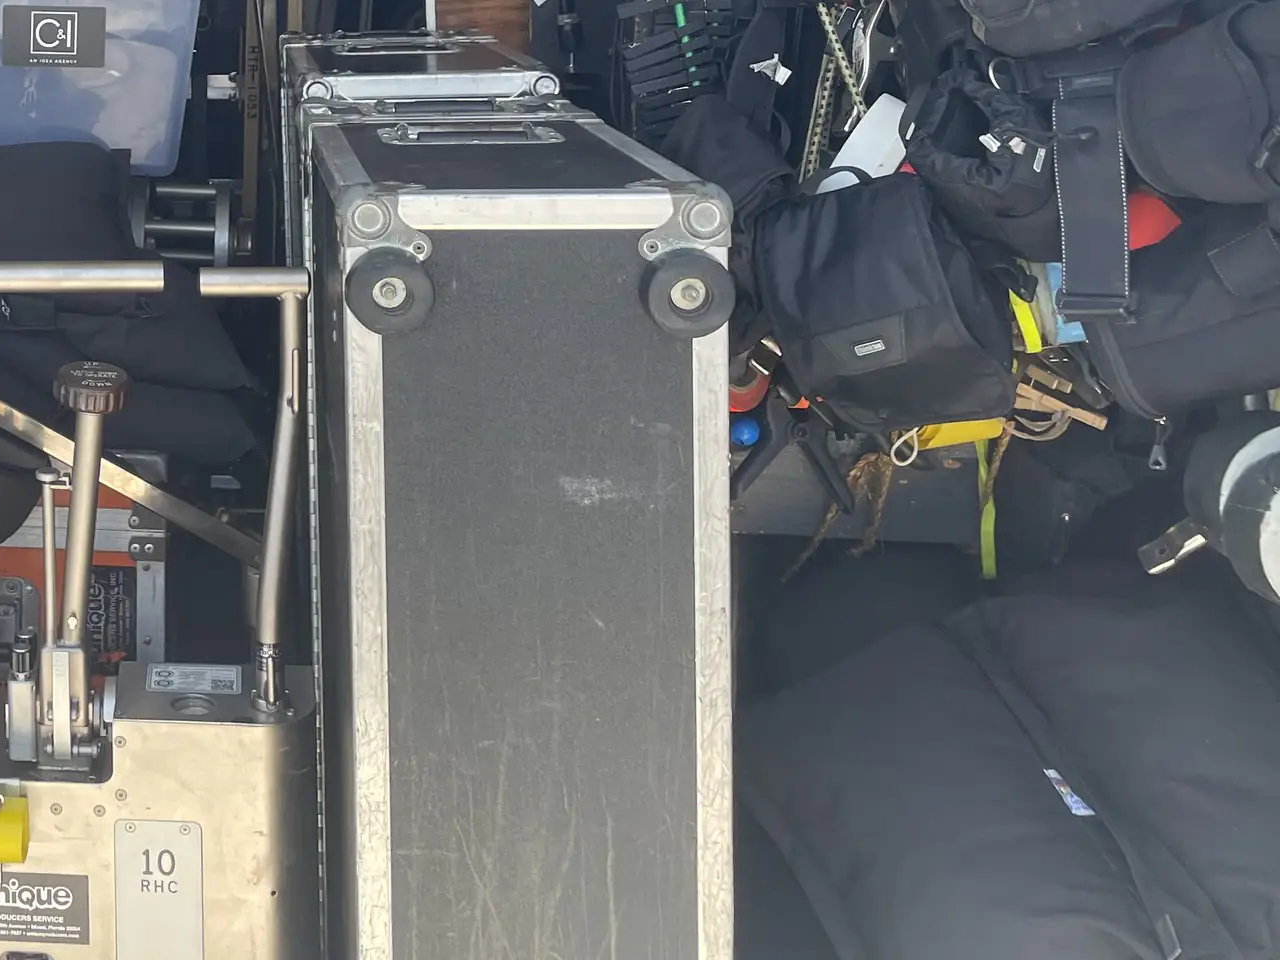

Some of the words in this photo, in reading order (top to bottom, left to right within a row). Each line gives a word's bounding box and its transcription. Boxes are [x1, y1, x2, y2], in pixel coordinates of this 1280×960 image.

[35, 18, 72, 48] C&I
[141, 848, 176, 877] 10
[140, 879, 179, 894] RHC
[32, 914, 64, 924] SERVICE
